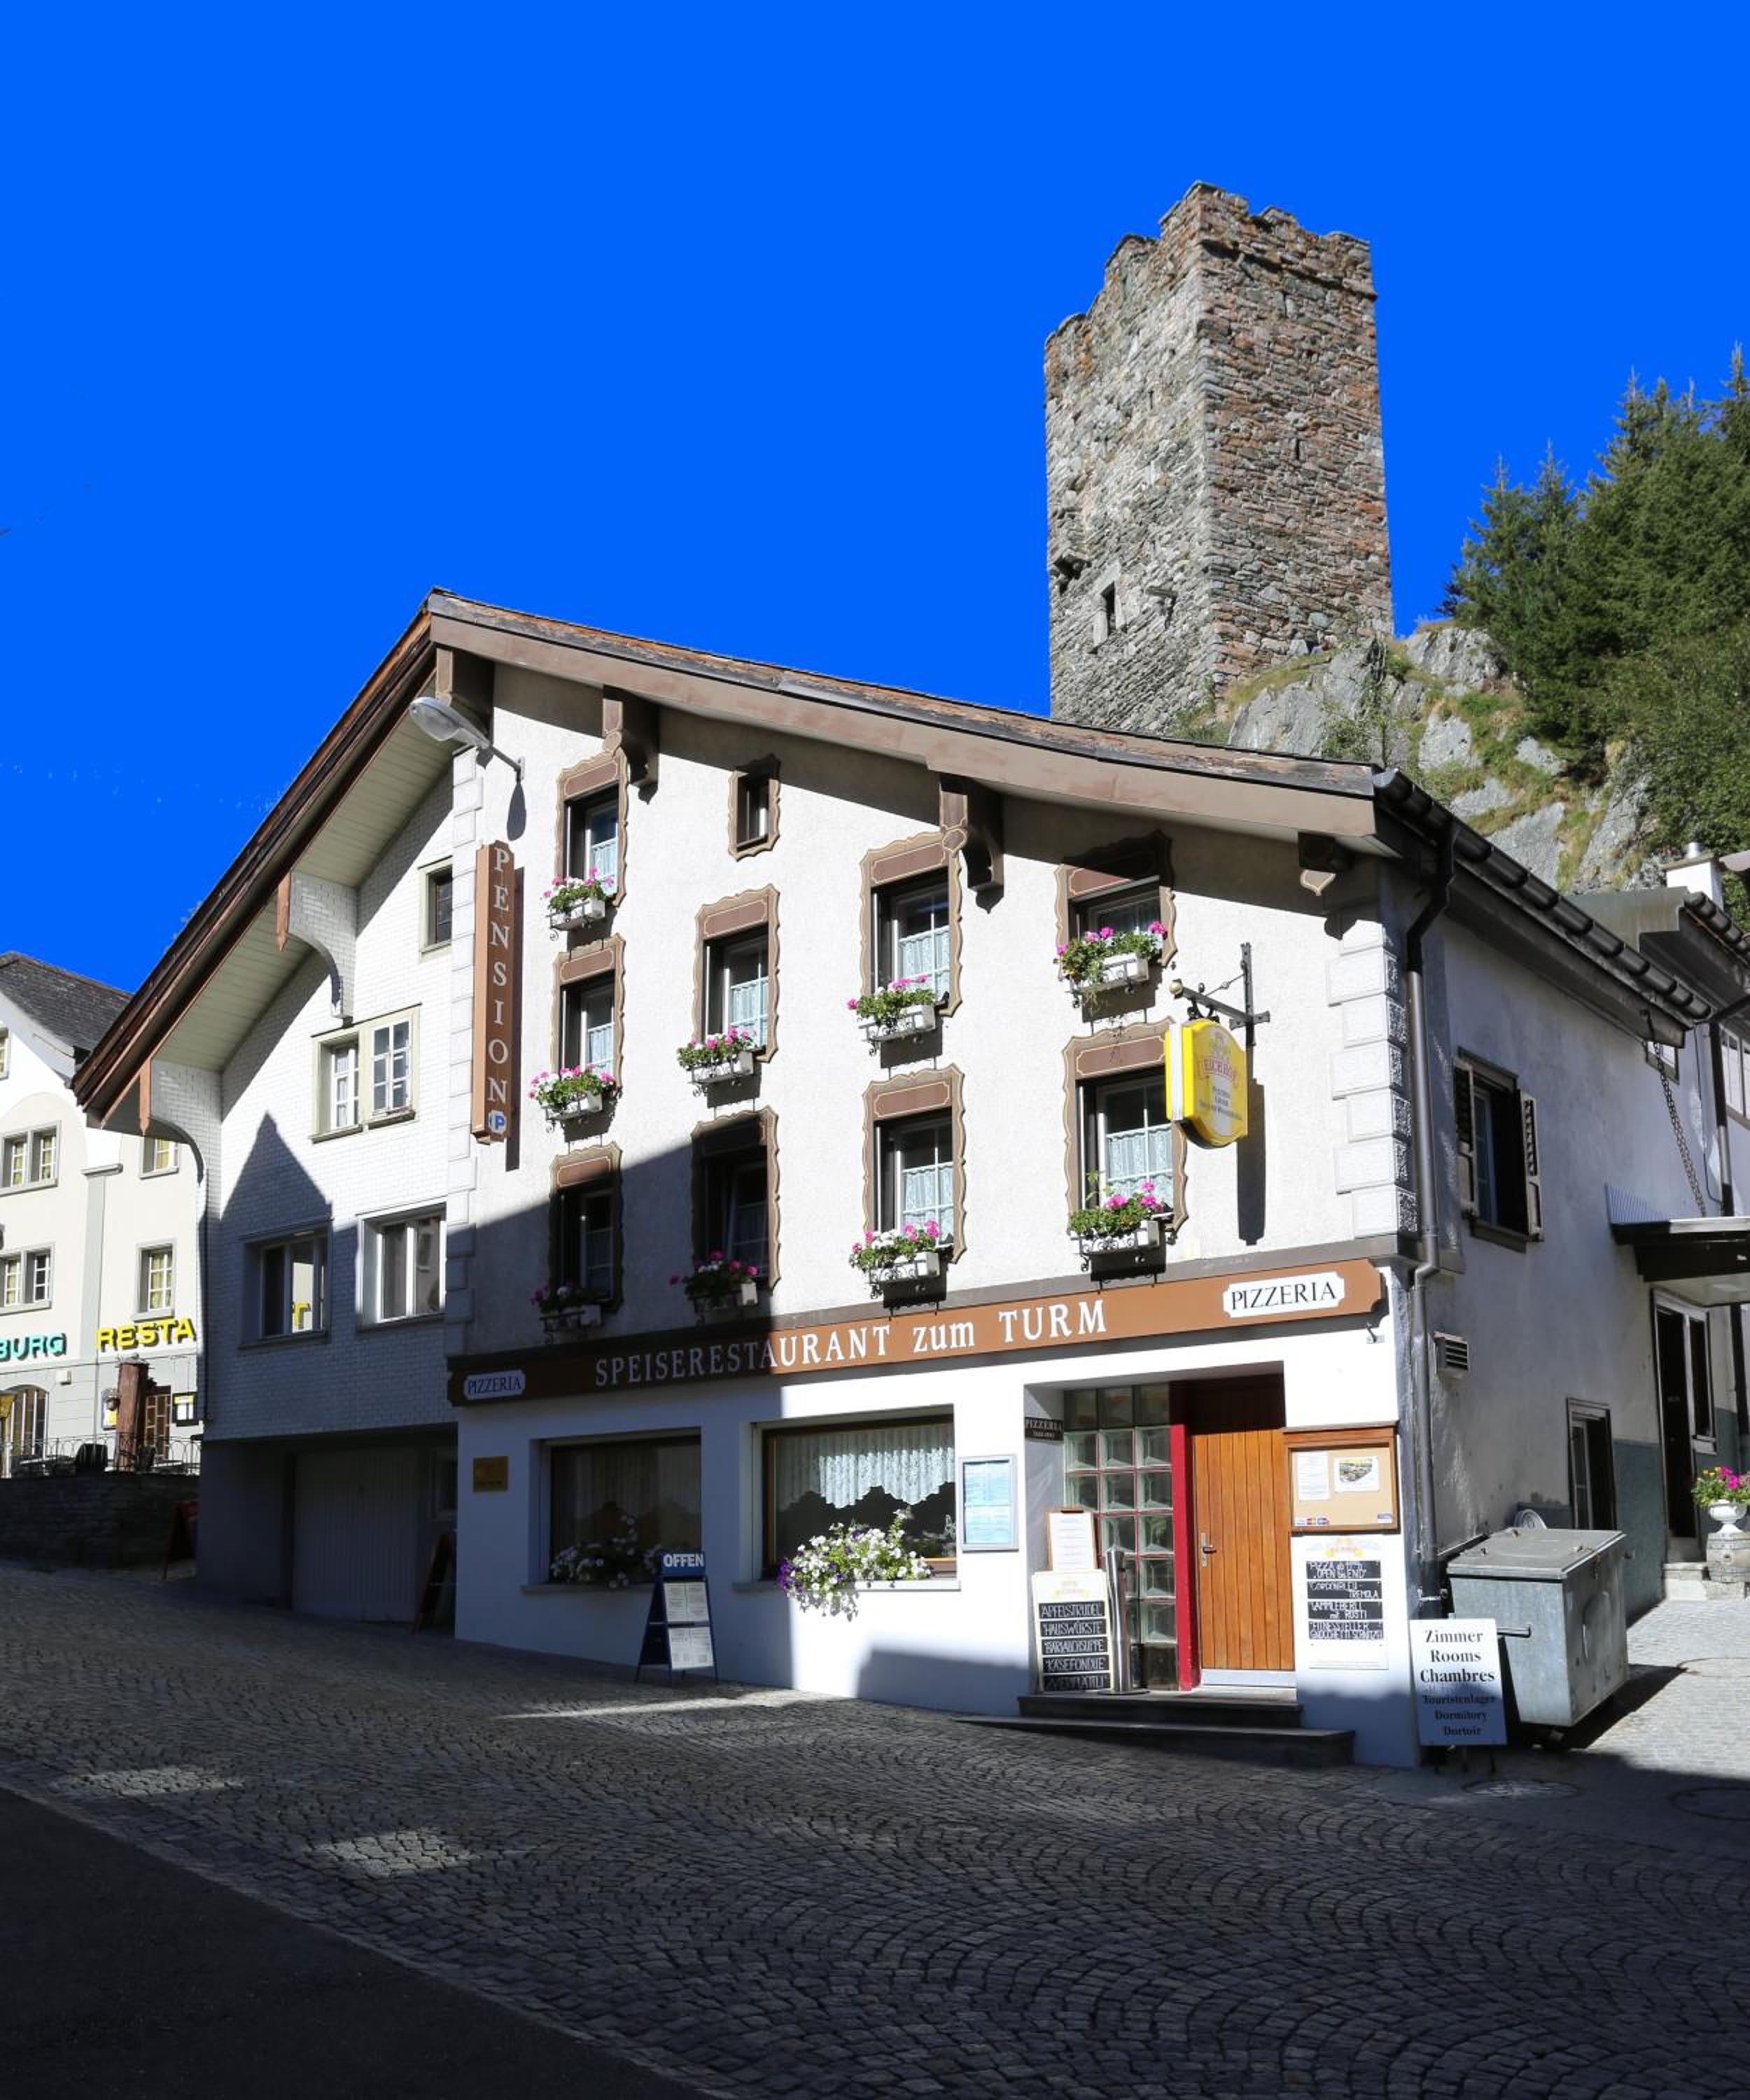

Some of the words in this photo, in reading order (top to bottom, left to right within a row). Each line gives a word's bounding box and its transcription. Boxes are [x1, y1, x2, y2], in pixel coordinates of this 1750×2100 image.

[488, 846, 510, 1105] PENSION
[1231, 1282, 1337, 1311] PIZZERIA
[95, 1317, 196, 1352] RESTA
[595, 1325, 890, 1387] SPEISERESTAURANT
[913, 1321, 975, 1354] zum
[999, 1299, 1107, 1343] TURM
[0, 1333, 65, 1361] BURG
[468, 1376, 524, 1395] PIZZERIA
[663, 1553, 704, 1567] OFFEN
[1424, 1630, 1483, 1643] Zimmer
[1430, 1649, 1481, 1662] Rooms
[1420, 1668, 1495, 1683] Chambres
[1434, 1710, 1488, 1723] Dormitory
[1443, 1726, 1482, 1736] Dortoir
